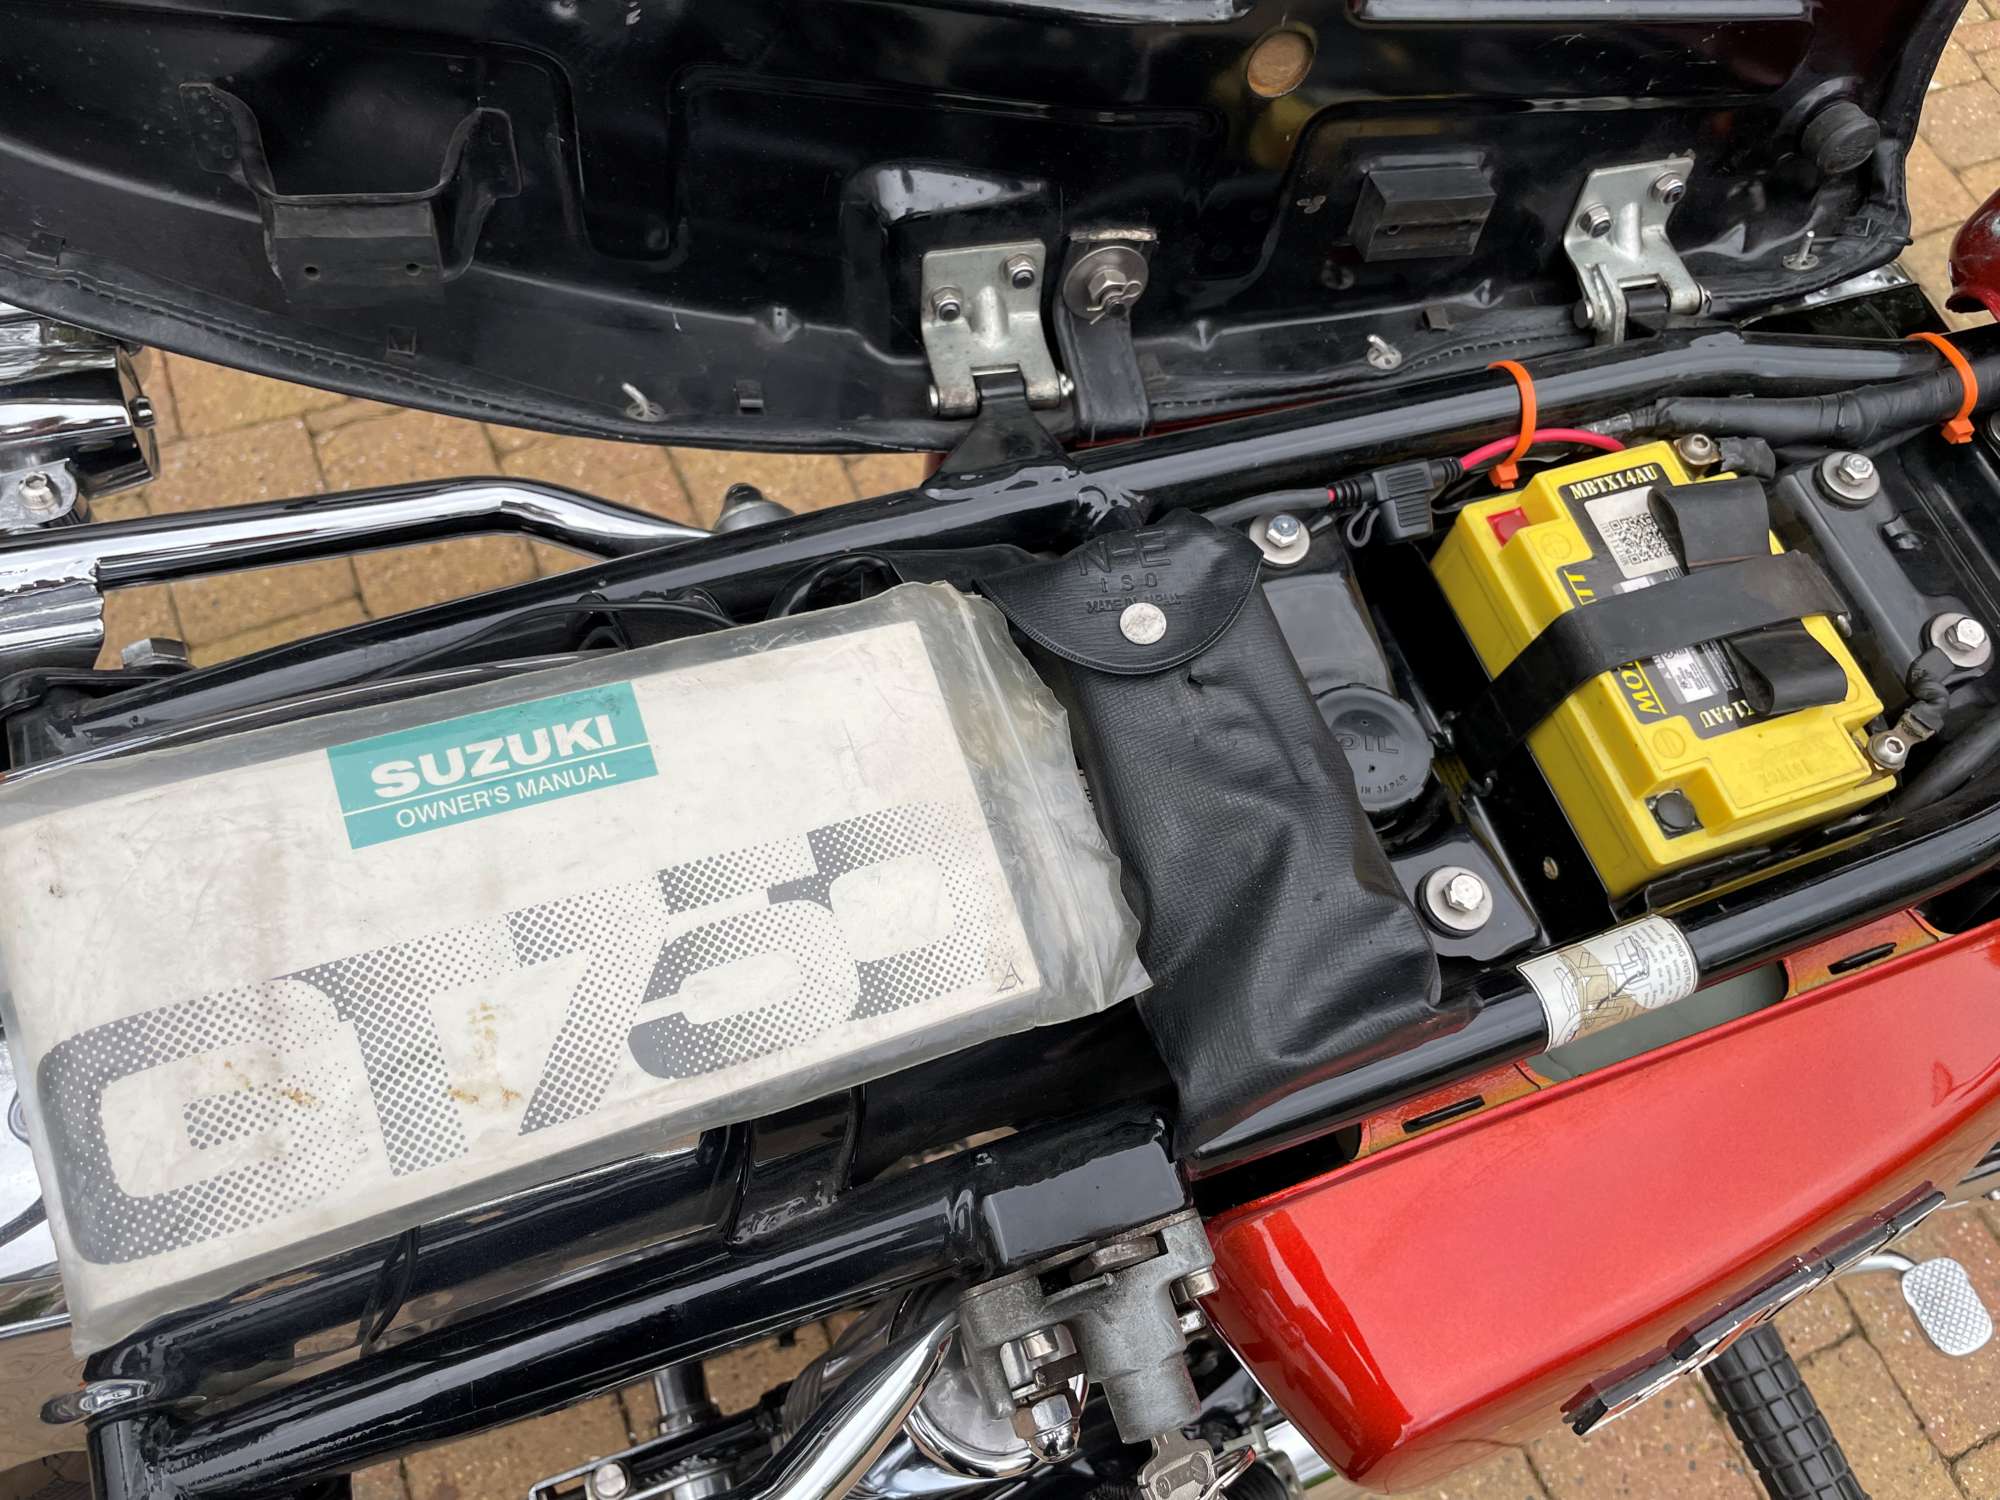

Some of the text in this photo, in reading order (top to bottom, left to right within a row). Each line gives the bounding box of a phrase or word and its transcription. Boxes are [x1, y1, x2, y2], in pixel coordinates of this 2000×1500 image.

[1569, 465, 1659, 500] MBTX14AU
[370, 714, 617, 798] SUZUKI
[395, 762, 617, 828] OWNER'S MANUAL
[38, 801, 1006, 1262] GT750
